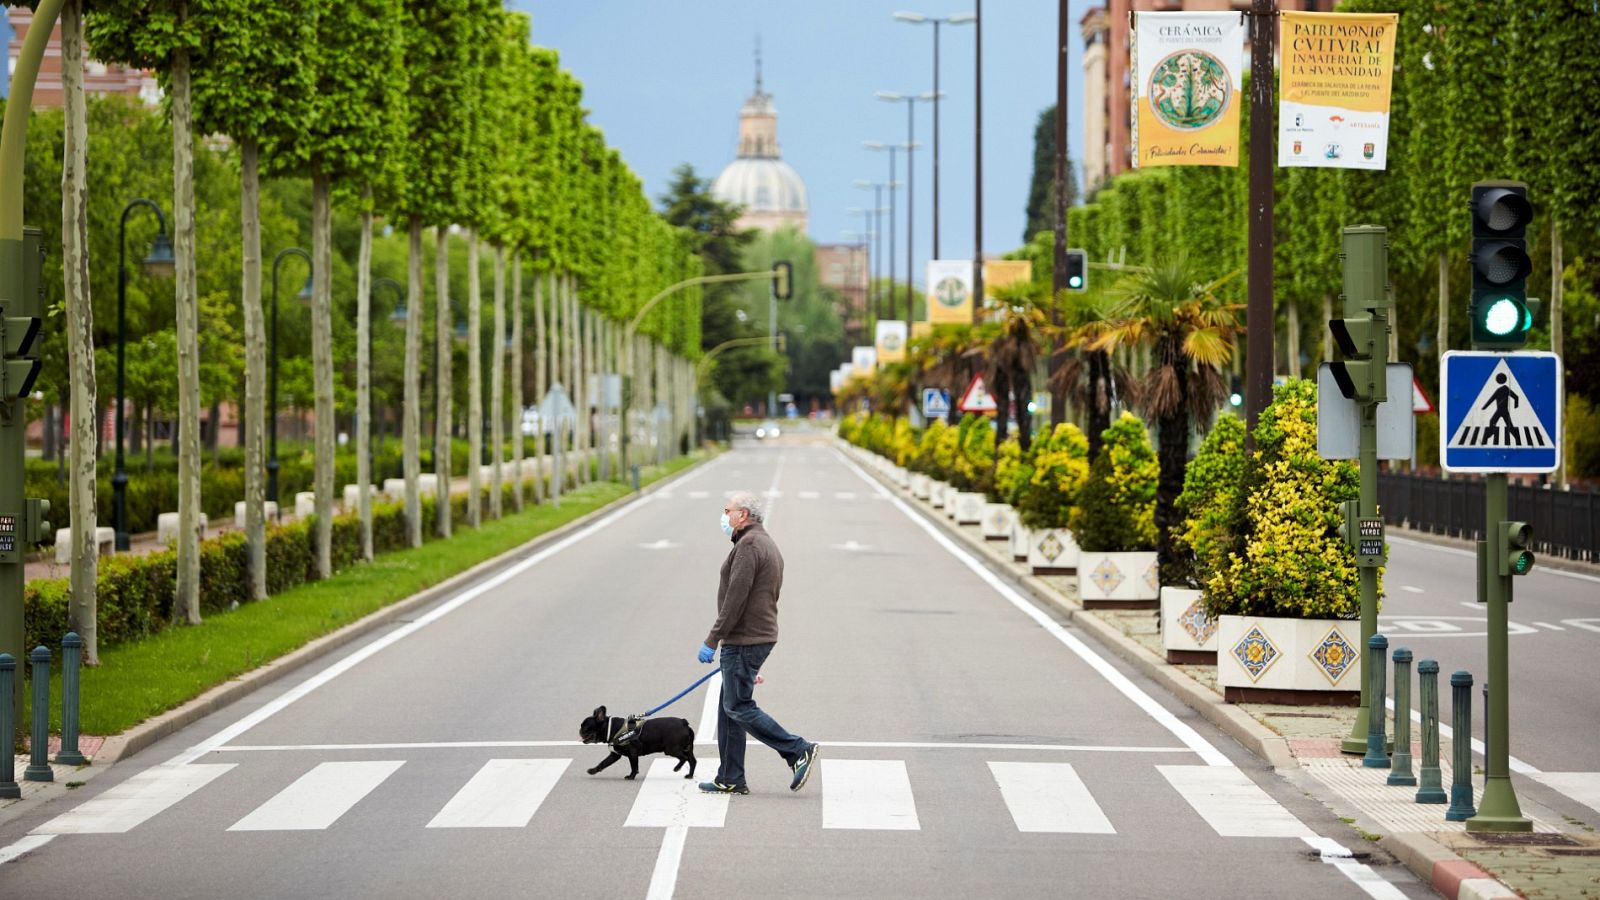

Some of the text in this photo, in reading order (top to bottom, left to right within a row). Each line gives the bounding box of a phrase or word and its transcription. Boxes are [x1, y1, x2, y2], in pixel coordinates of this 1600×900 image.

[1159, 23, 1222, 36] CERÁMICA
[1295, 23, 1385, 38] PATRIMONIO
[1293, 38, 1381, 53] CVLTVRAL
[1293, 53, 1382, 65] INMATERIAL DE
[1292, 65, 1304, 75] LA
